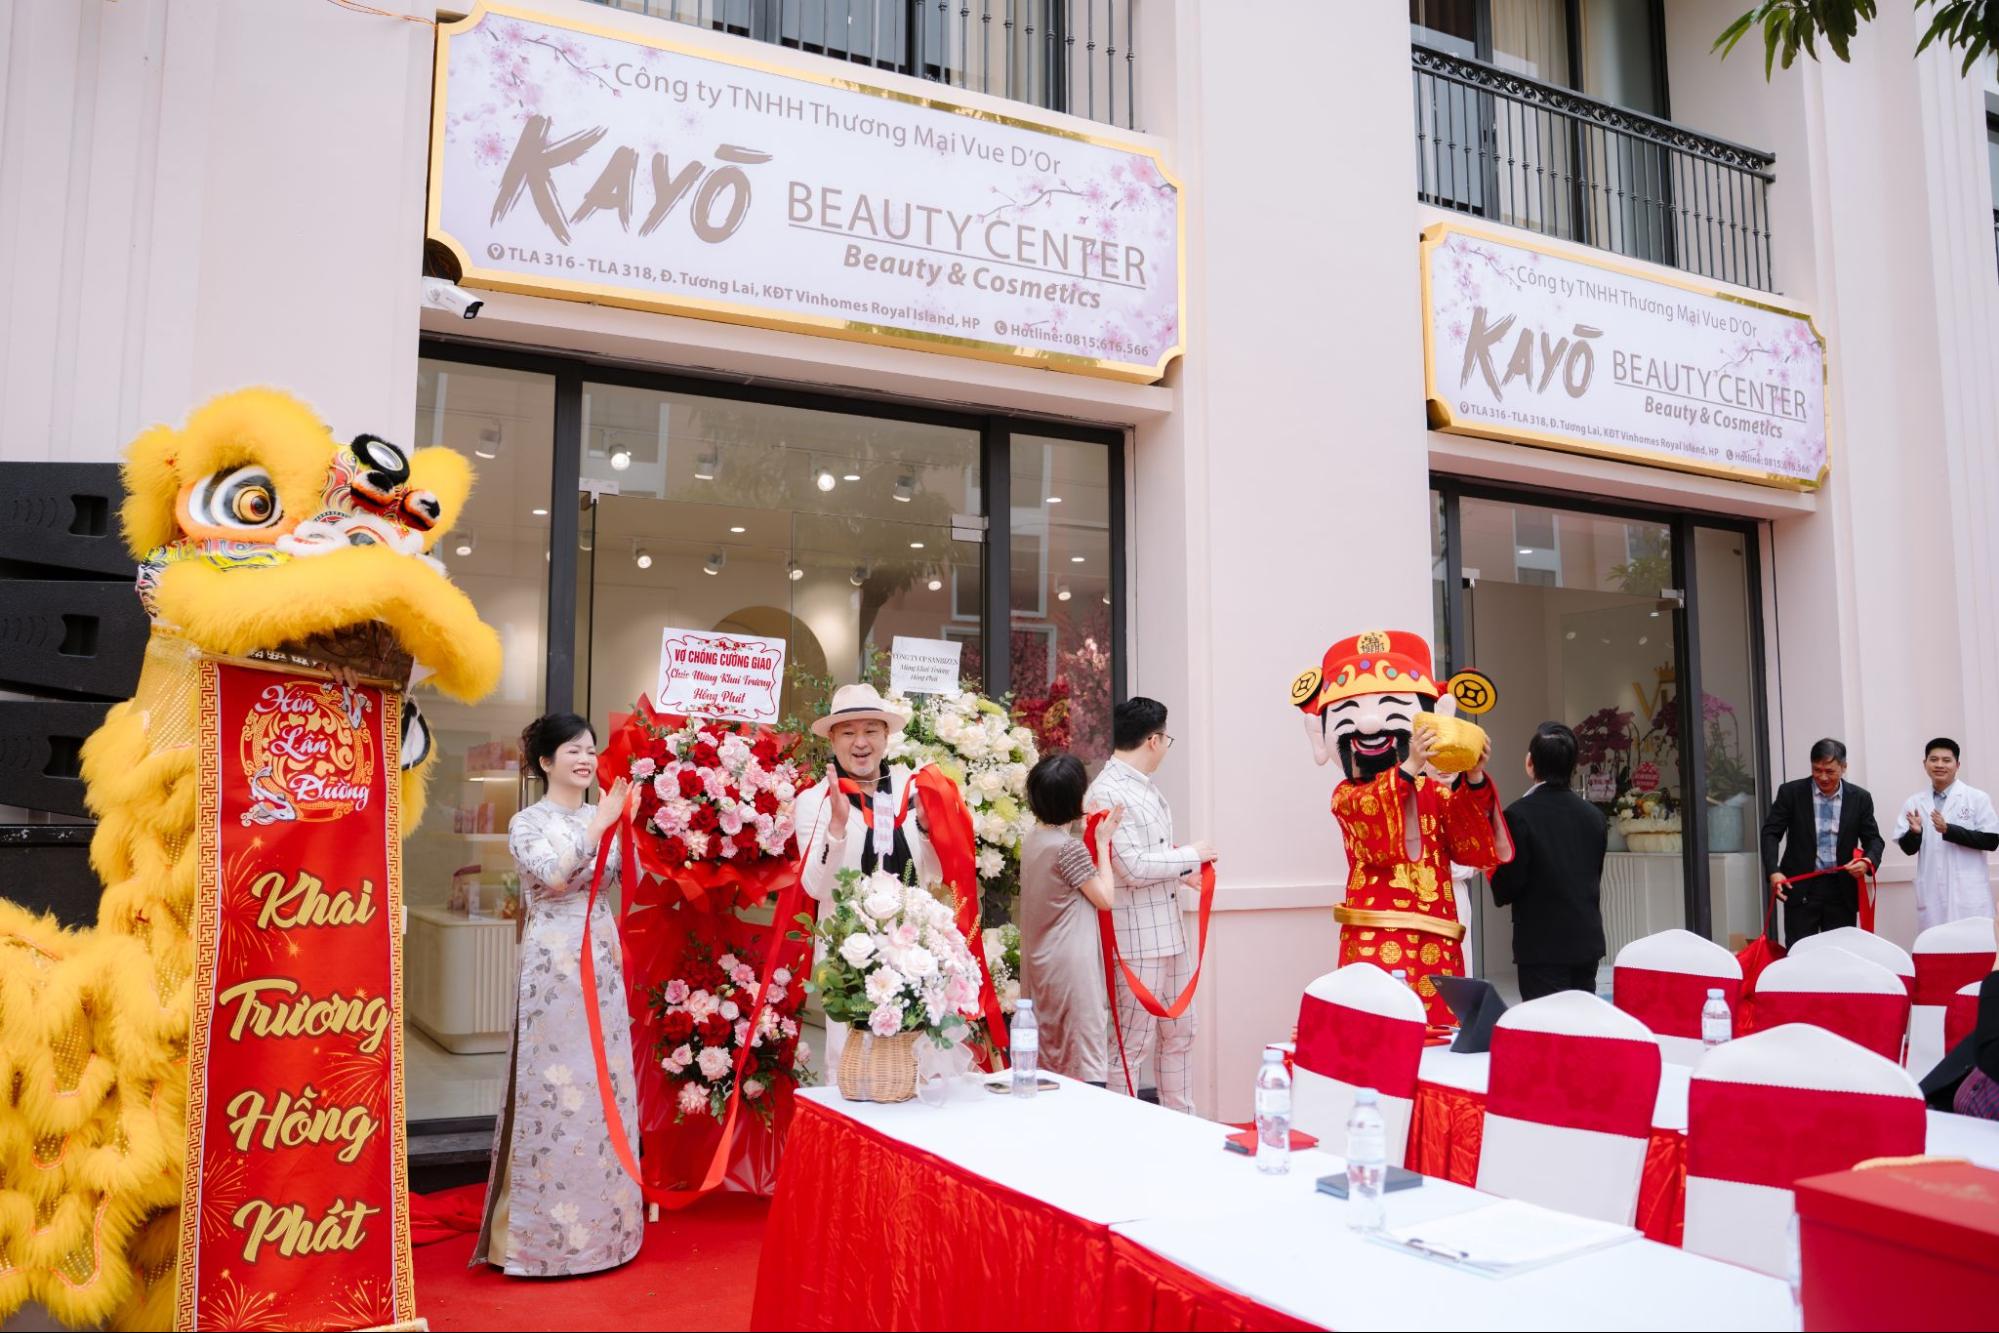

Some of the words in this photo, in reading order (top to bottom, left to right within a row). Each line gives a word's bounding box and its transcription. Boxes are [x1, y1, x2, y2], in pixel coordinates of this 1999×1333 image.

[615, 63, 688, 103] Công
[697, 82, 722, 109] ty
[728, 85, 803, 121] TNHH
[810, 102, 906, 147] Thương
[914, 125, 956, 156] Mại
[961, 135, 1005, 162] Vue
[1012, 146, 1061, 174] D'Or
[788, 181, 973, 250] BEAUTY
[984, 220, 1146, 284] CENTER
[508, 247, 540, 264] TLA
[544, 252, 575, 269] 316
[588, 258, 618, 275] TLA
[622, 263, 655, 281] 318,
[660, 269, 677, 284] Đ.
[680, 272, 728, 293] Tương
[732, 279, 759, 297] Lai,
[763, 284, 793, 299] KĐT
[796, 289, 868, 313] Vinhomes
[871, 302, 910, 322] Royal
[913, 308, 959, 329] Island,
[962, 316, 980, 329] HP
[844, 243, 943, 286] Beauty
[948, 263, 966, 285] &
[972, 267, 1101, 309] Cosmetics
[1517, 266, 1556, 294] Công
[1560, 278, 1574, 298] ty
[1577, 280, 1618, 304] TNHH
[1621, 290, 1673, 322] Thương
[1677, 305, 1700, 326] Mại
[1702, 312, 1727, 330] Vue
[1011, 325, 1062, 343] Hotline:
[1613, 350, 1711, 398] BEAUTY
[1719, 374, 1807, 418] CENTER
[1471, 404, 1488, 416] TLA
[1490, 408, 1506, 419] 316
[1512, 412, 1528, 423] TLA
[1530, 415, 1548, 428] 318,
[1560, 420, 1585, 435] Tương
[1621, 431, 1659, 446] Vinhomes
[1661, 438, 1682, 451] Royal
[1709, 447, 1718, 456] HP
[1645, 396, 1697, 425] Beauty
[1700, 409, 1709, 424] &
[1714, 411, 1783, 439] Cosmetics
[675, 649, 686, 664] VỢ
[720, 651, 749, 668] CƯỜNG
[751, 657, 772, 670] GIAO
[692, 669, 718, 685] Mừng
[720, 672, 742, 685] Khai
[743, 675, 773, 691] Trương
[693, 688, 718, 704] Hồng
[720, 690, 746, 703] Phát
[288, 774, 369, 811] Đường
[252, 871, 376, 929] Khai
[219, 978, 392, 1053] Trương
[226, 1087, 379, 1163] Hồng
[232, 1199, 380, 1263] Phát
